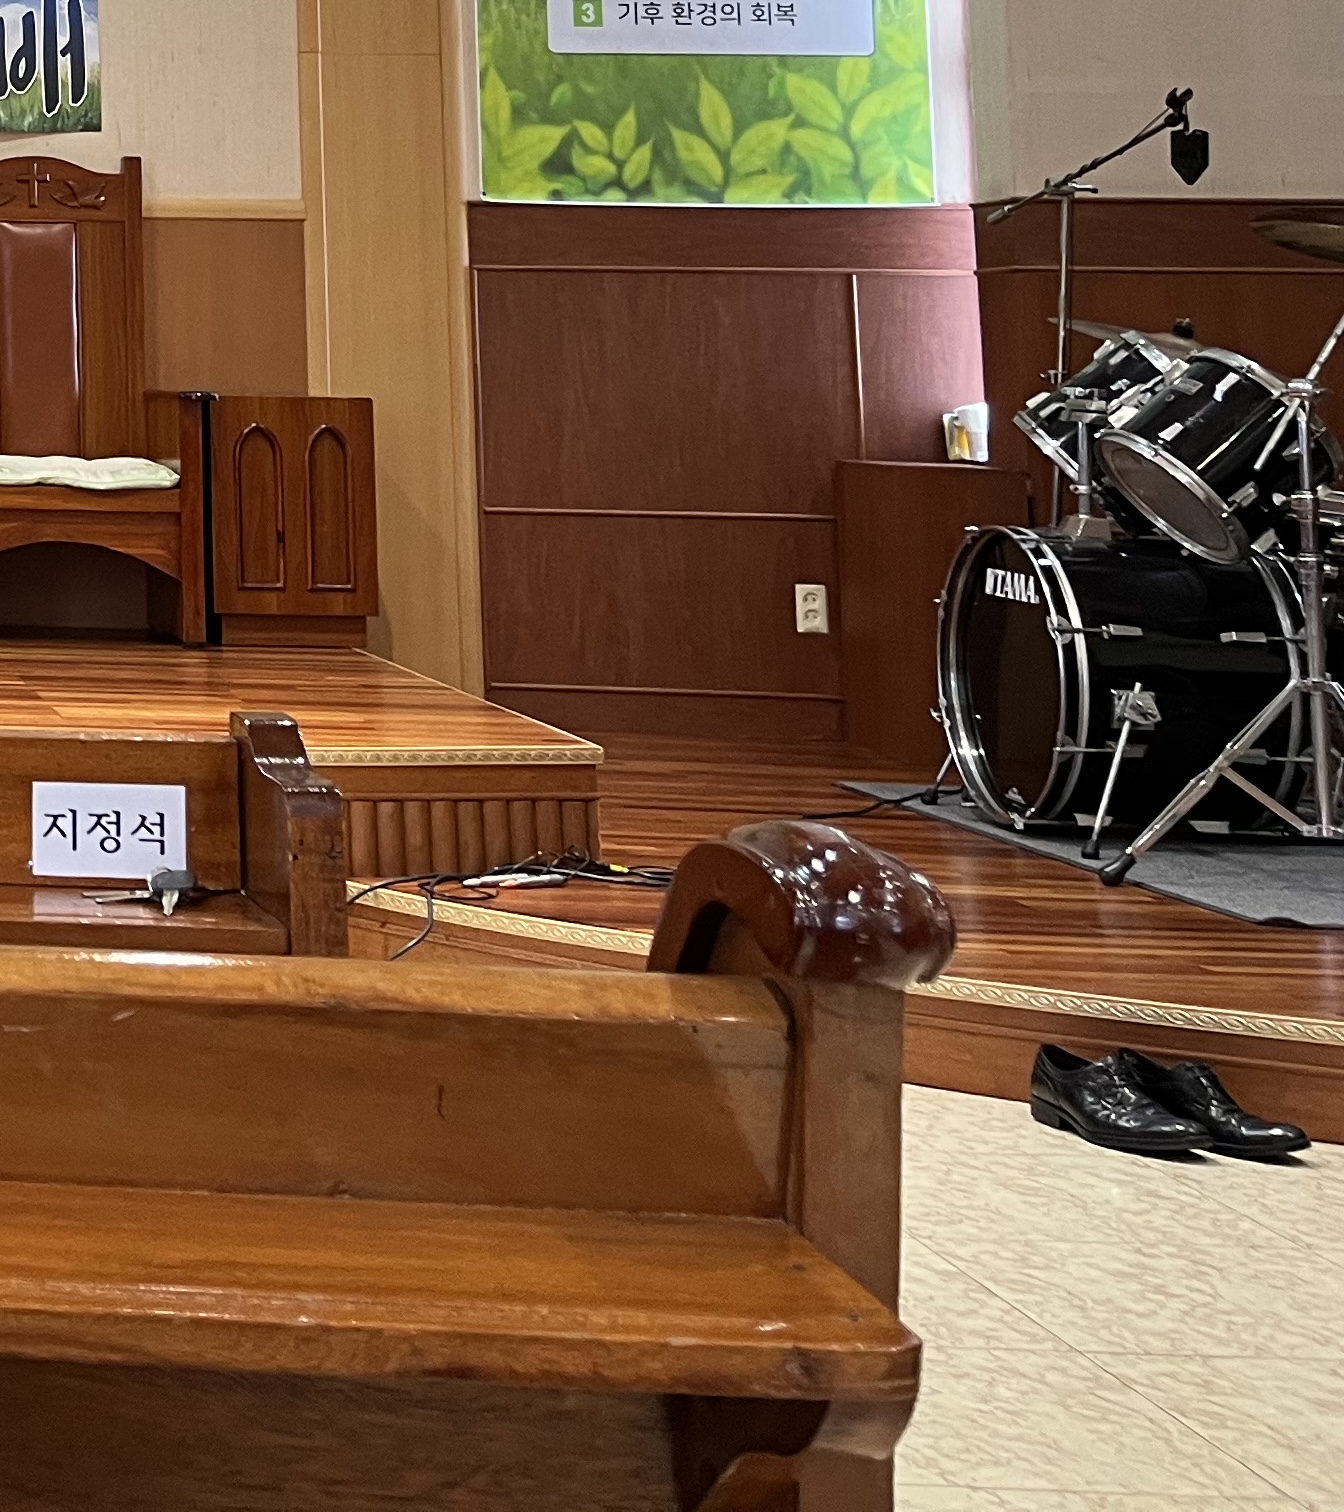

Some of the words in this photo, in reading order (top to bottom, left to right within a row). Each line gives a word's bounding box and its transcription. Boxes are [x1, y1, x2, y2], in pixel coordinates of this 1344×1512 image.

[581, 2, 596, 23] 3
[617, 1, 664, 26] 기후
[671, 1, 741, 27] 환경의
[750, 2, 797, 27] 회복
[994, 569, 1036, 603] TAMA
[42, 808, 166, 856] 지정석
